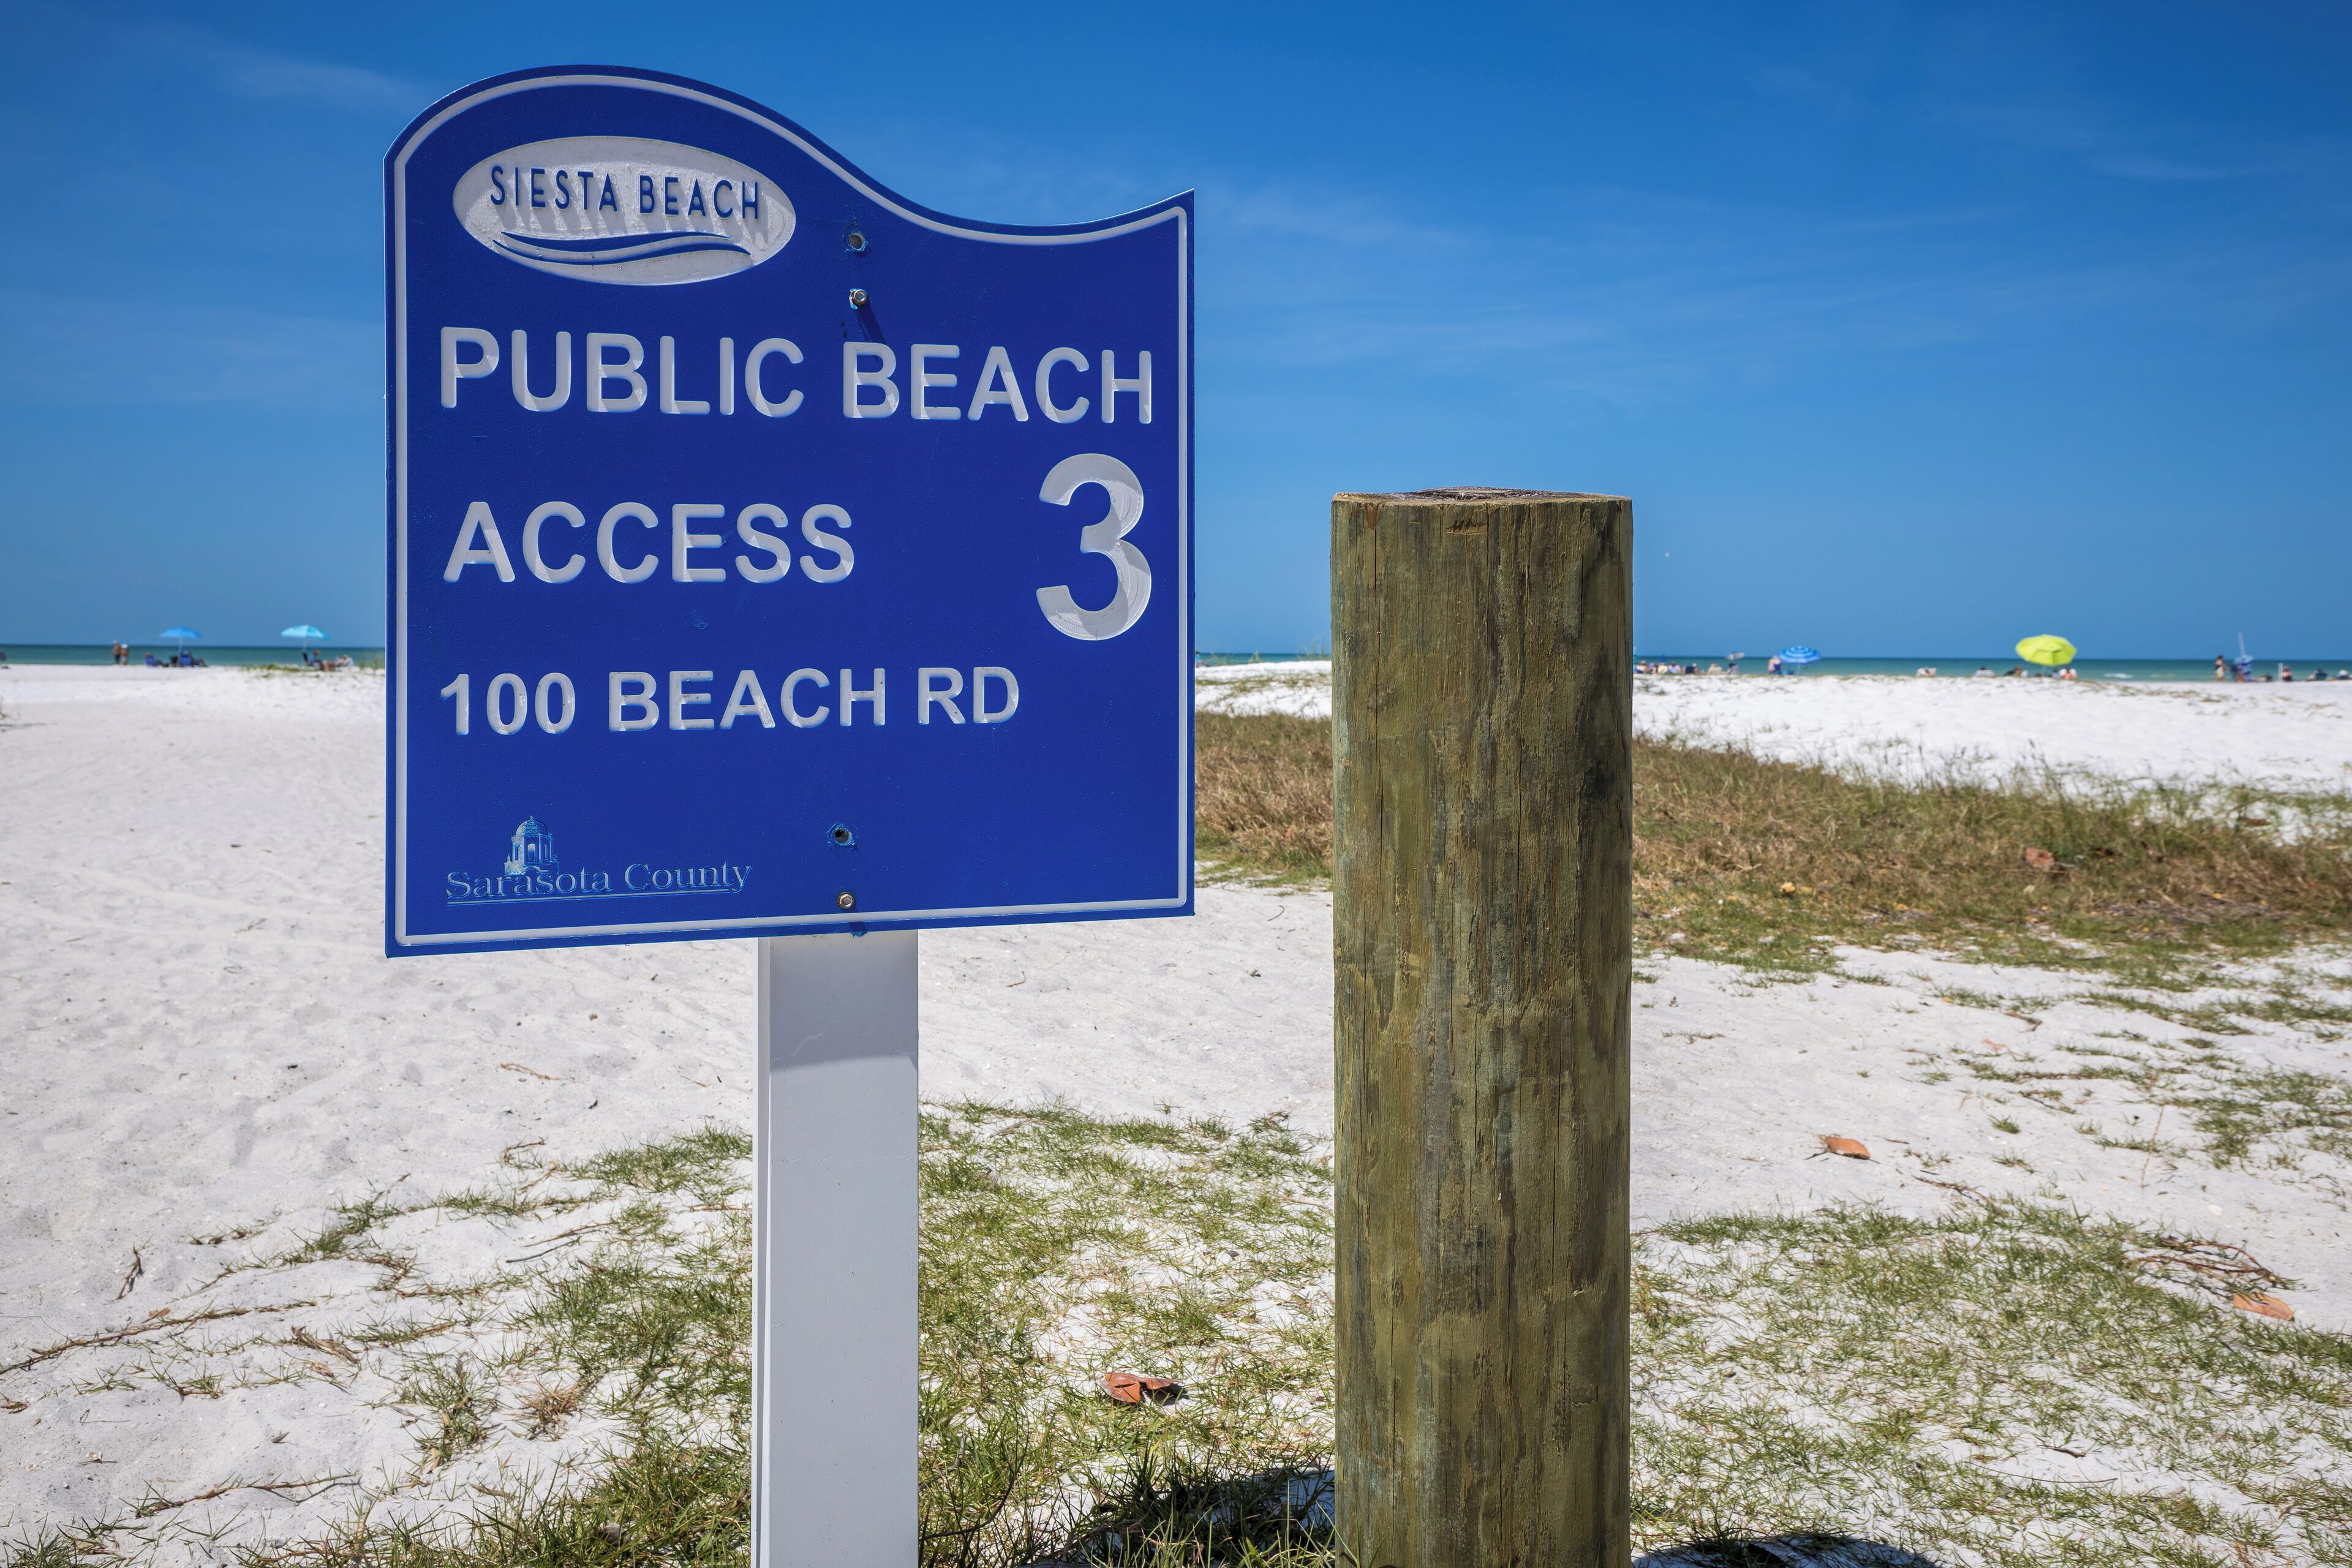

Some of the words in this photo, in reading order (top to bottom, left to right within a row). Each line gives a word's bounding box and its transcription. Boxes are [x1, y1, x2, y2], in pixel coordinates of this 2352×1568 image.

[490, 165, 617, 212] SIESTA
[639, 175, 759, 220] BEACH
[440, 326, 805, 418] PUBLIC
[842, 341, 1153, 424] BEACH
[442, 500, 855, 584] ACCESS
[1036, 453, 1152, 641] 3
[439, 671, 576, 735] 100
[609, 667, 886, 733] BEACH
[918, 666, 1020, 725] RD
[445, 867, 612, 899] Sarasota
[624, 861, 754, 894] County
